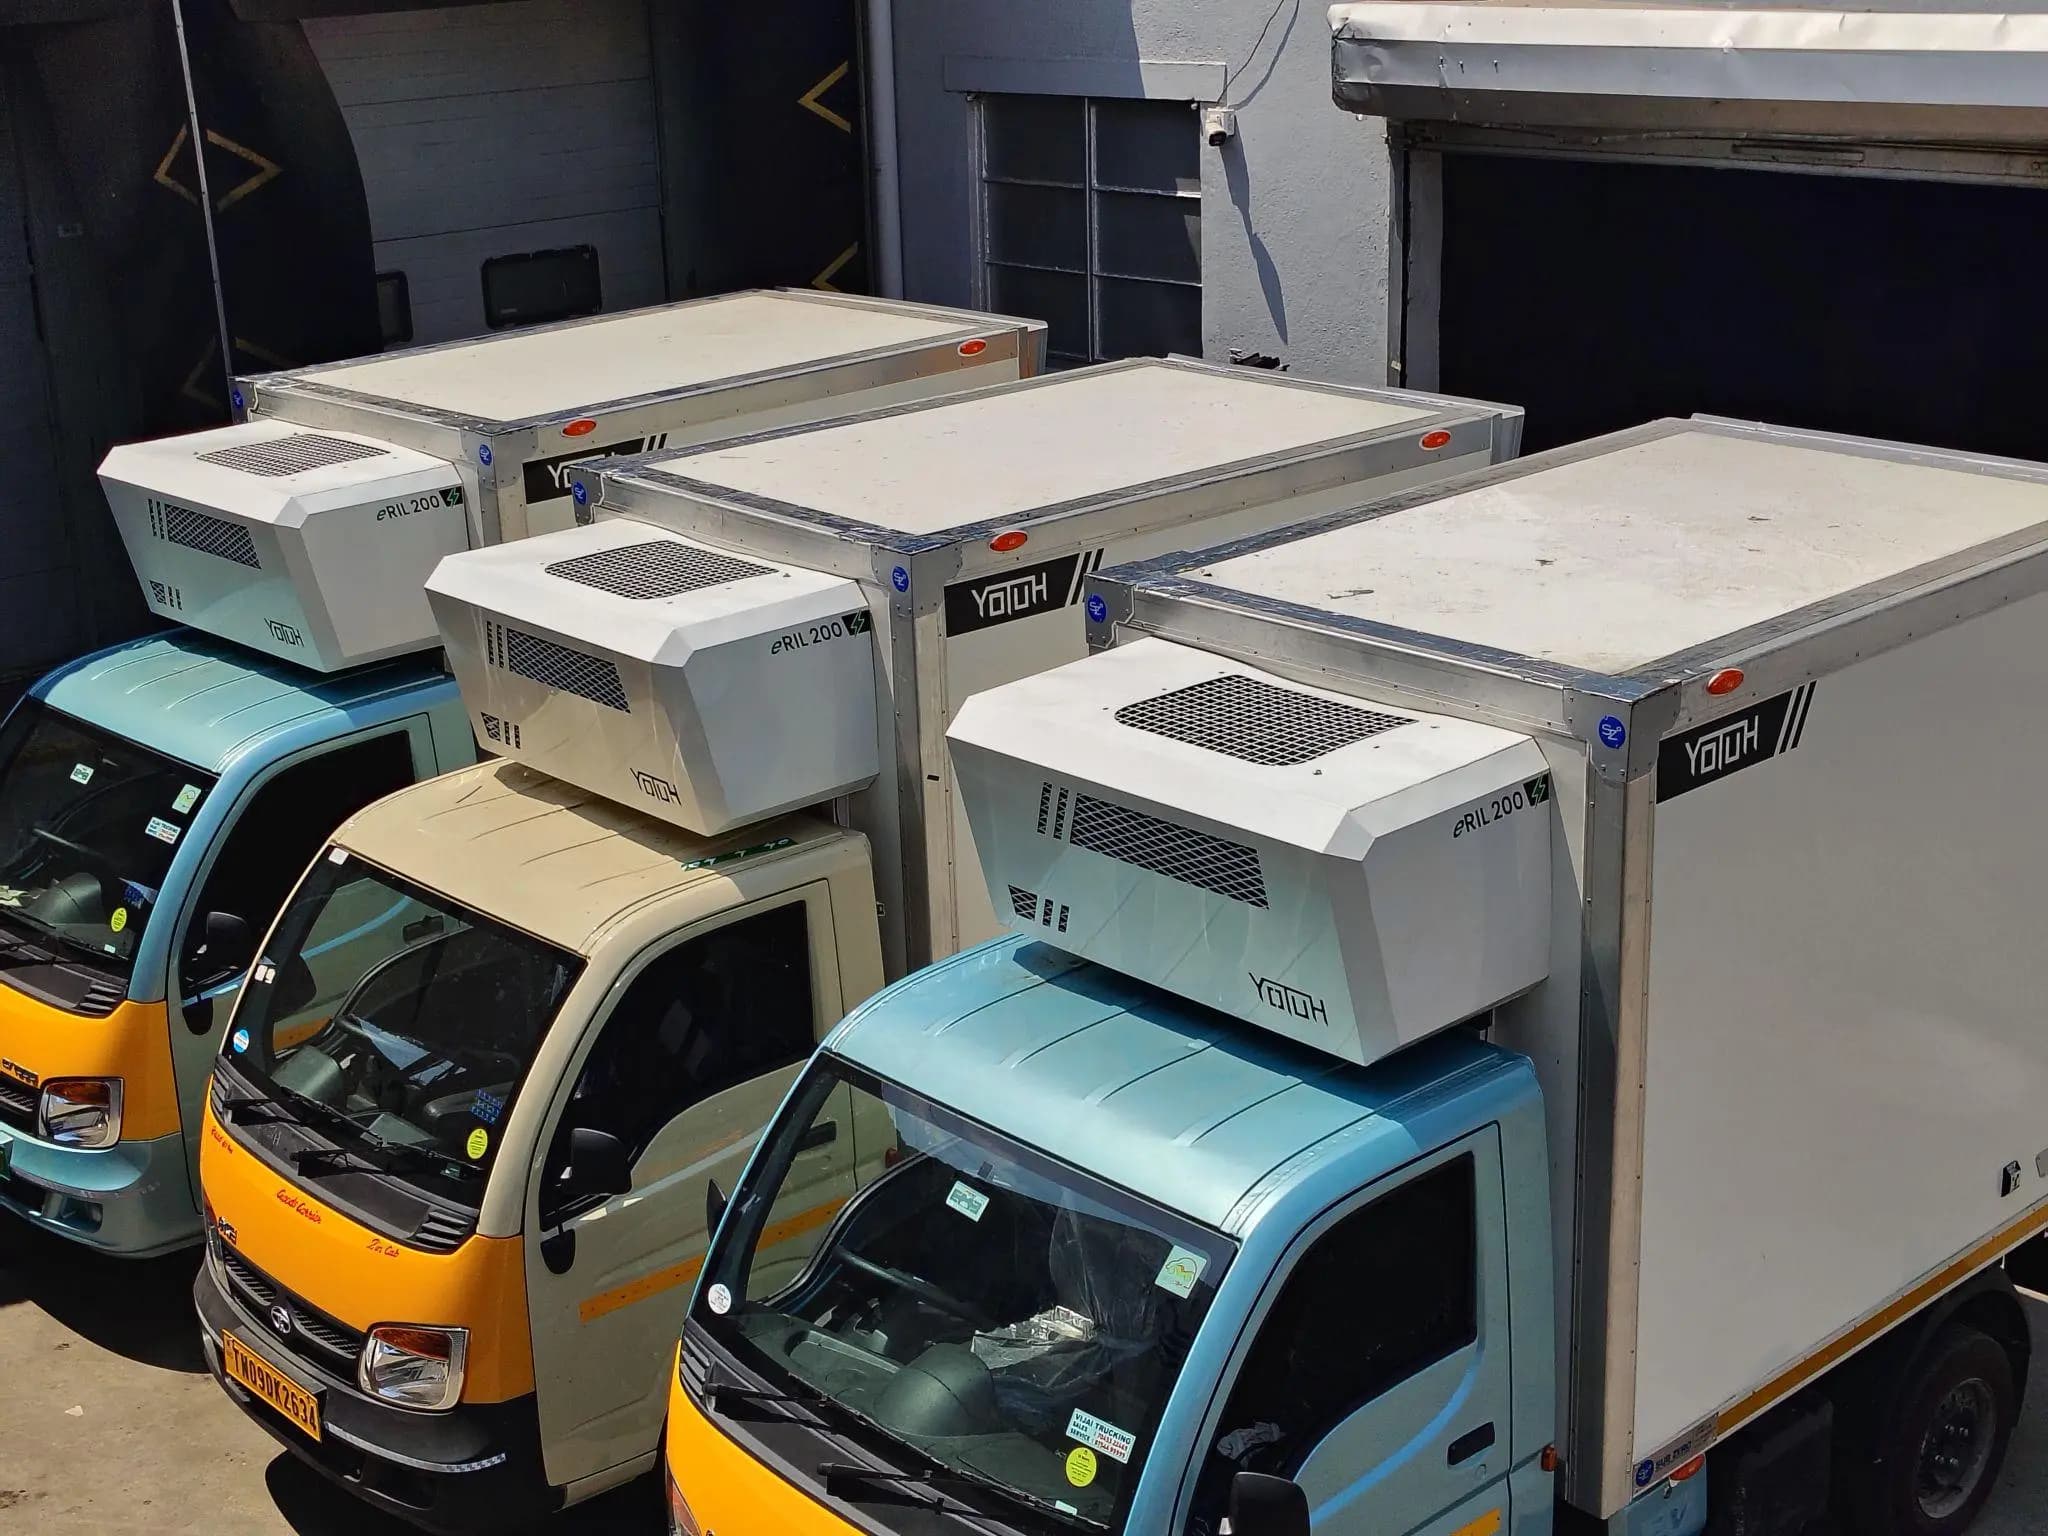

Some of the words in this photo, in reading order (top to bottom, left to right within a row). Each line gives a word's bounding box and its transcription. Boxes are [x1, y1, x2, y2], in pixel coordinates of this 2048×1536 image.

[376, 499, 409, 521] eRIL
[411, 495, 440, 514] 200
[971, 572, 1047, 618] YOTUH
[771, 632, 809, 655] eRIL
[810, 622, 842, 644] 200
[1685, 715, 1759, 777] YOTUH
[1453, 807, 1490, 838] eRIL
[1491, 791, 1523, 821] 200
[1075, 1413, 1093, 1427] VIJAI
[1095, 1423, 1132, 1445] TRUCKING
